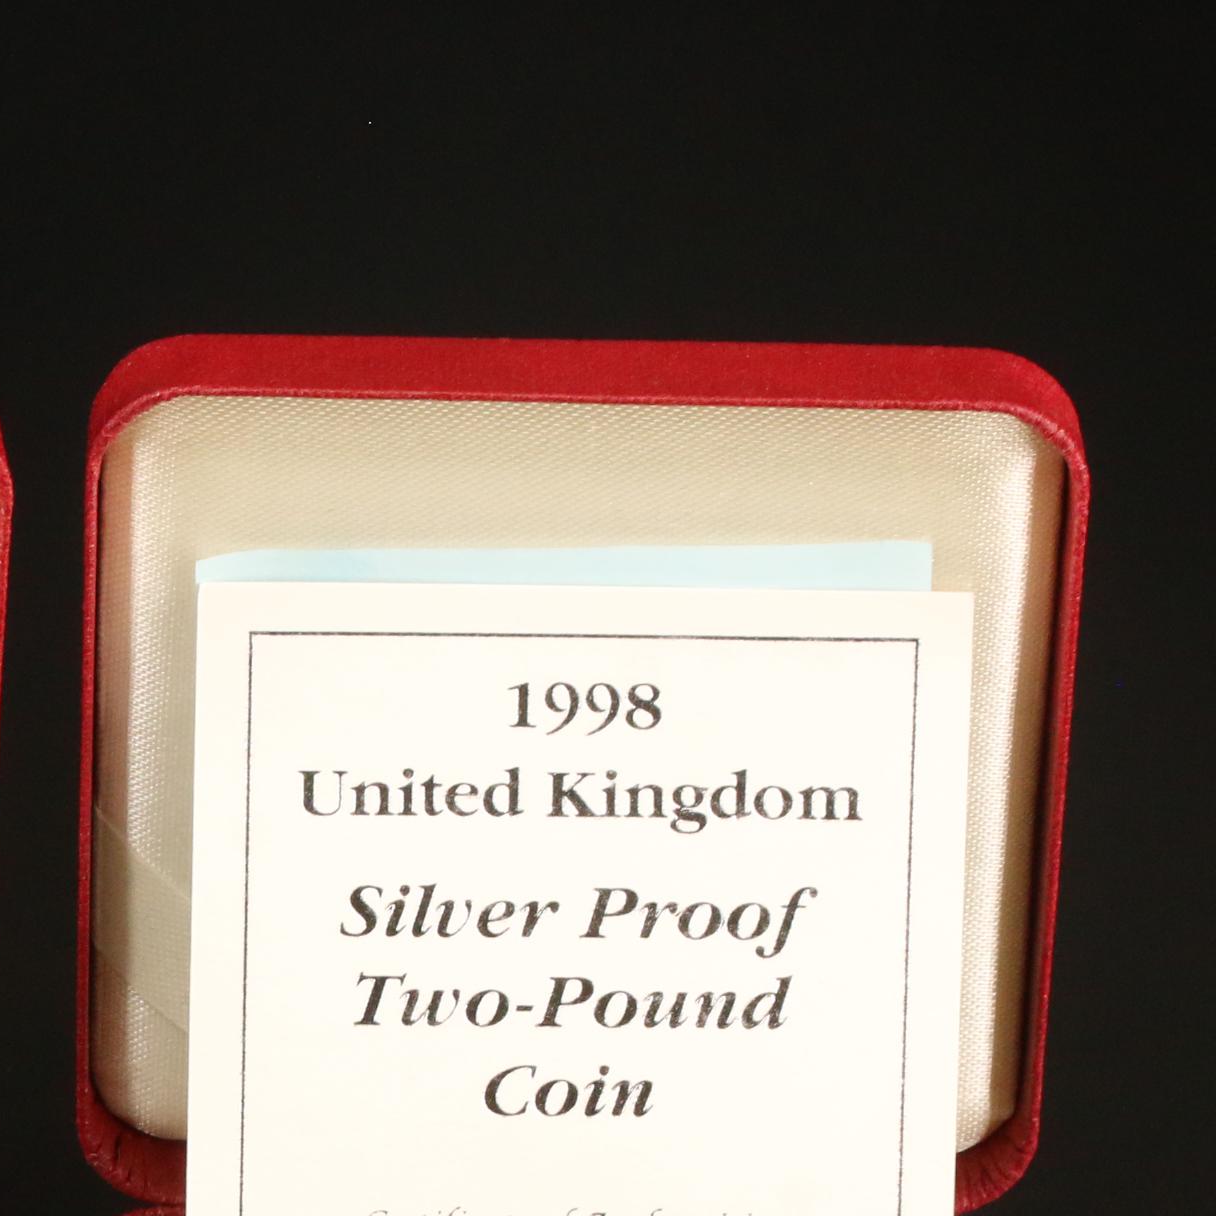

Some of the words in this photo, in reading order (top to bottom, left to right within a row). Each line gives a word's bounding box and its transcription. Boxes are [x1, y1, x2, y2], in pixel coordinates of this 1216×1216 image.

[509, 682, 661, 735] 1998
[299, 767, 523, 817] United
[548, 769, 862, 834] Kingdom
[340, 884, 559, 938] Silver
[580, 887, 817, 958] Proof
[354, 972, 792, 1029] Two-Pound
[485, 1065, 652, 1117] Coin
